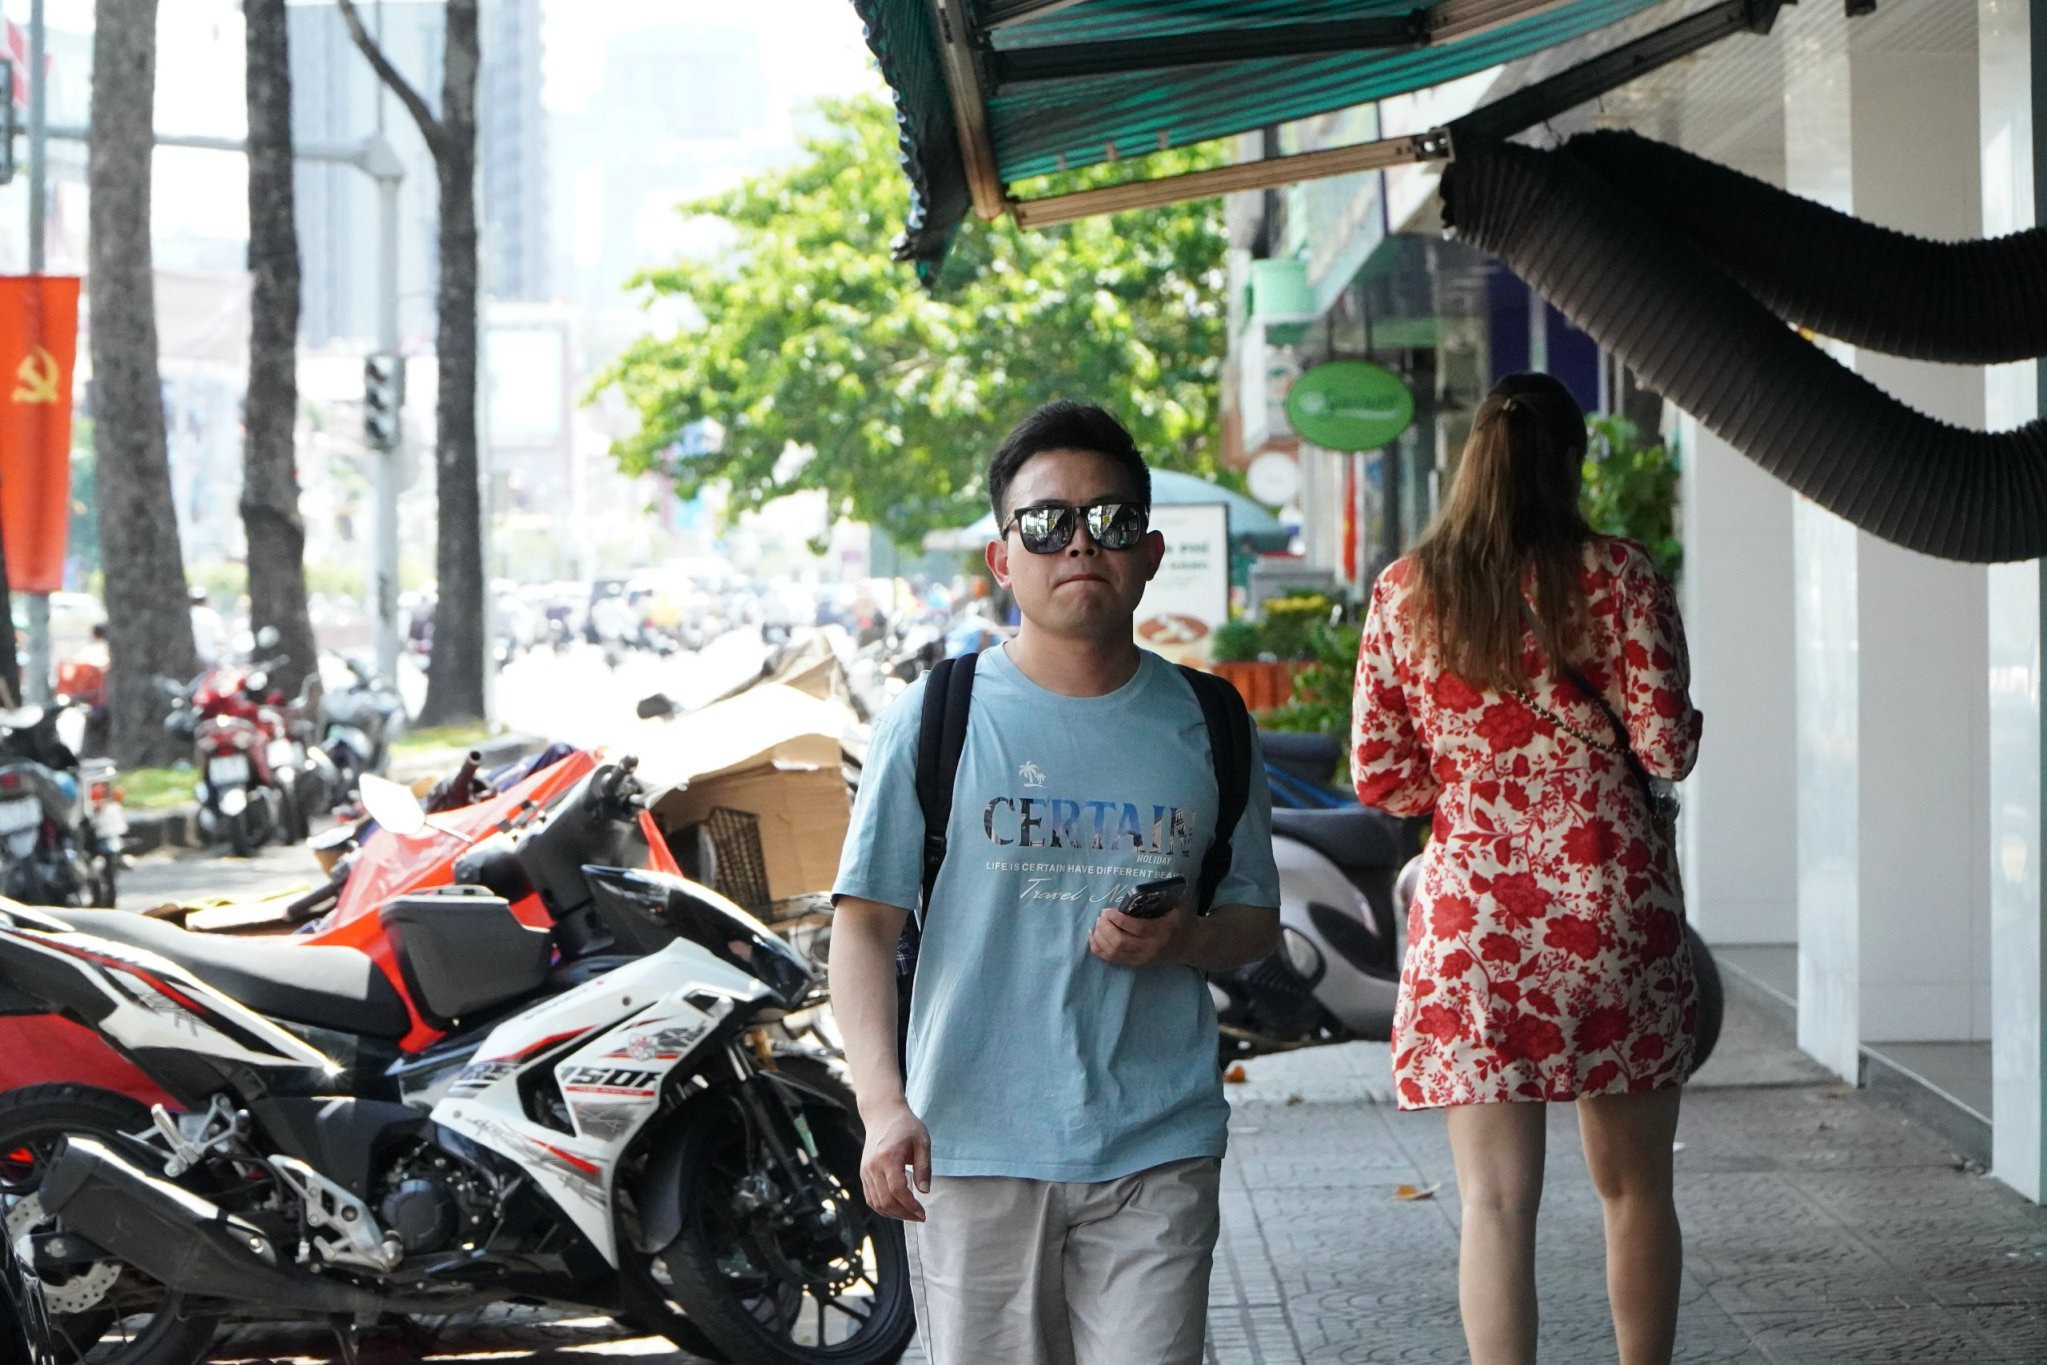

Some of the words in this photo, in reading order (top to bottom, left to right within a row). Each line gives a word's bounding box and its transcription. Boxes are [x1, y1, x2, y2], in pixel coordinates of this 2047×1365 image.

[983, 796, 1197, 857] CERTAIN
[986, 861, 1008, 871] LIFE
[1010, 863, 1020, 871] IS
[1021, 862, 1066, 873] CERTAIN
[1067, 864, 1095, 875] HAVE
[1096, 866, 1154, 879] DIFFERENT
[1137, 854, 1173, 866] HOLIDAY
[1019, 878, 1088, 901] Travel
